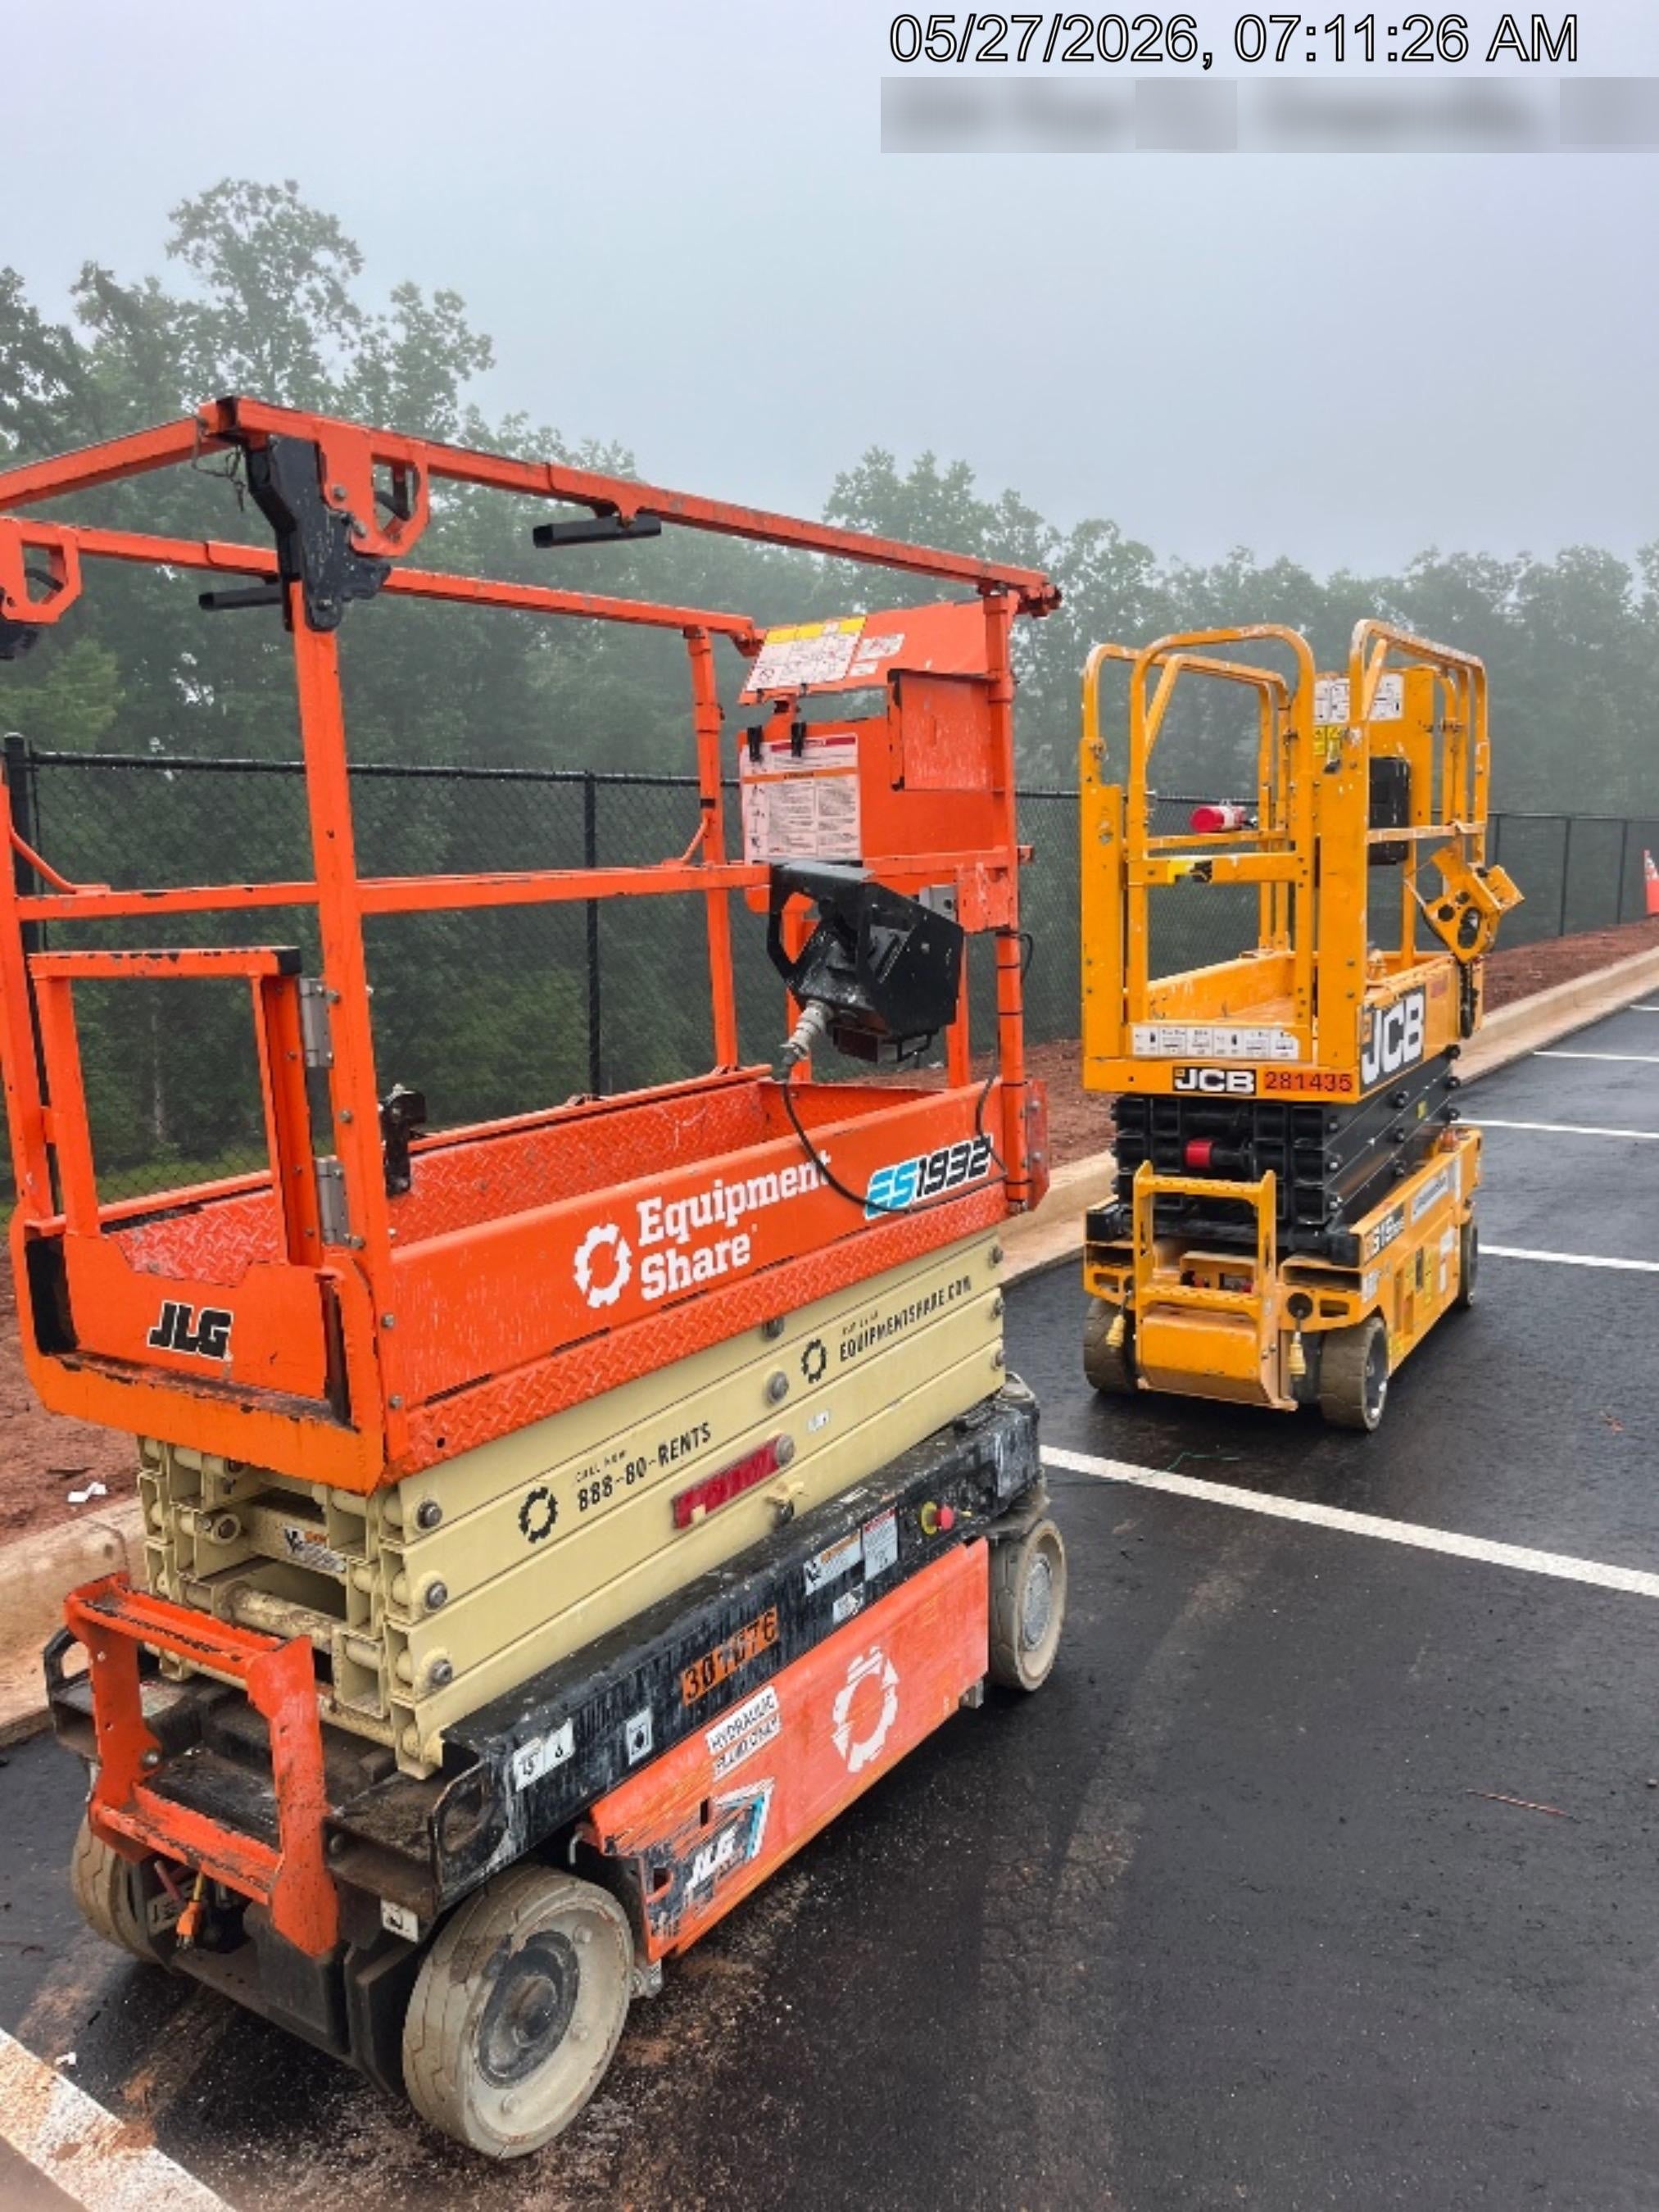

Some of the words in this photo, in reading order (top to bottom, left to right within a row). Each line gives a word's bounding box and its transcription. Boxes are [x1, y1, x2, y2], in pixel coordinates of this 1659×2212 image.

[1362, 995, 1426, 1086] JCB
[1174, 1067, 1256, 1094] JCB
[1264, 1071, 1353, 1092] 281435
[637, 1152, 832, 1247] Equipment
[864, 1133, 994, 1221] ES1932
[640, 1234, 751, 1301] Share
[147, 1300, 234, 1362] JLG
[578, 1422, 711, 1512] 888-80-RENTS
